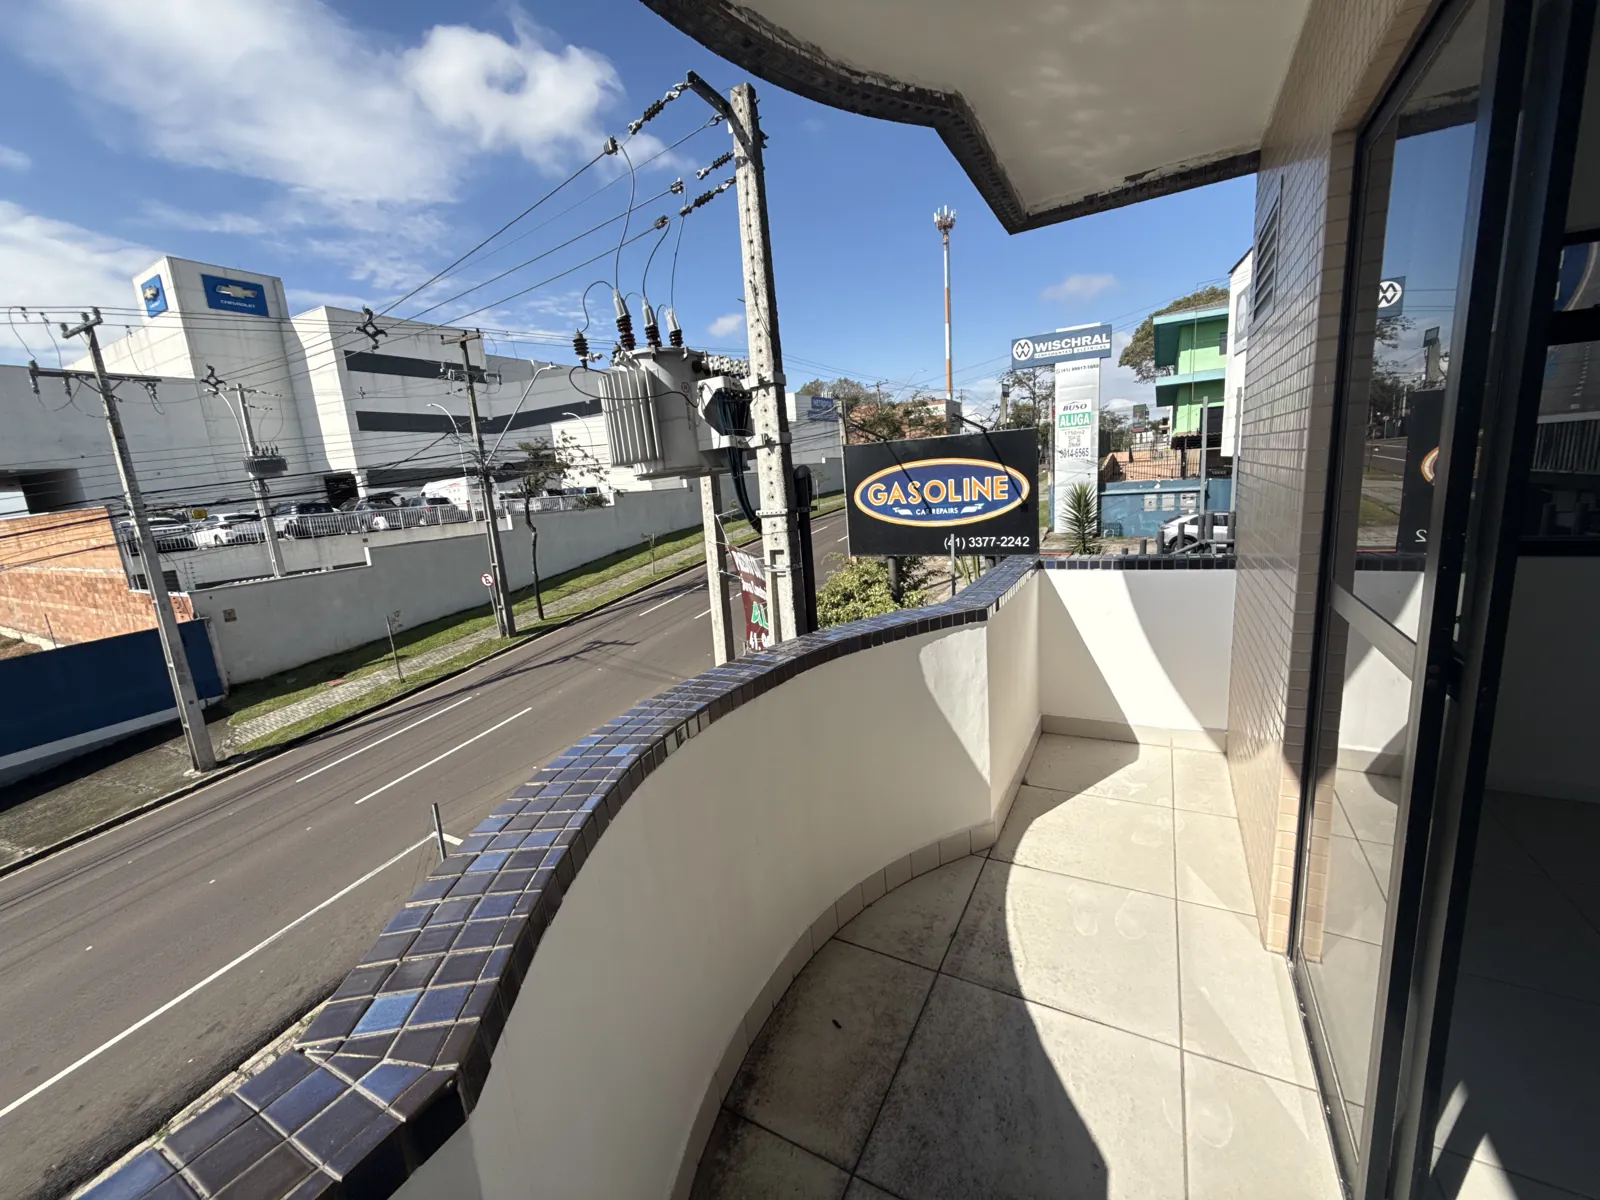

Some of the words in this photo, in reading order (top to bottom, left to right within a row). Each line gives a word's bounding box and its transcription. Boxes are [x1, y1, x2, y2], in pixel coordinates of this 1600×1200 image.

[220, 300, 256, 308] CHEVROLET
[1035, 333, 1110, 352] WISCHRAL
[1062, 403, 1088, 412] BUSO
[1060, 413, 1090, 427] ALUGA
[867, 475, 1009, 506] GASOLINE
[931, 506, 959, 515] REPAIRS
[968, 536, 1030, 548] 3377-2242
